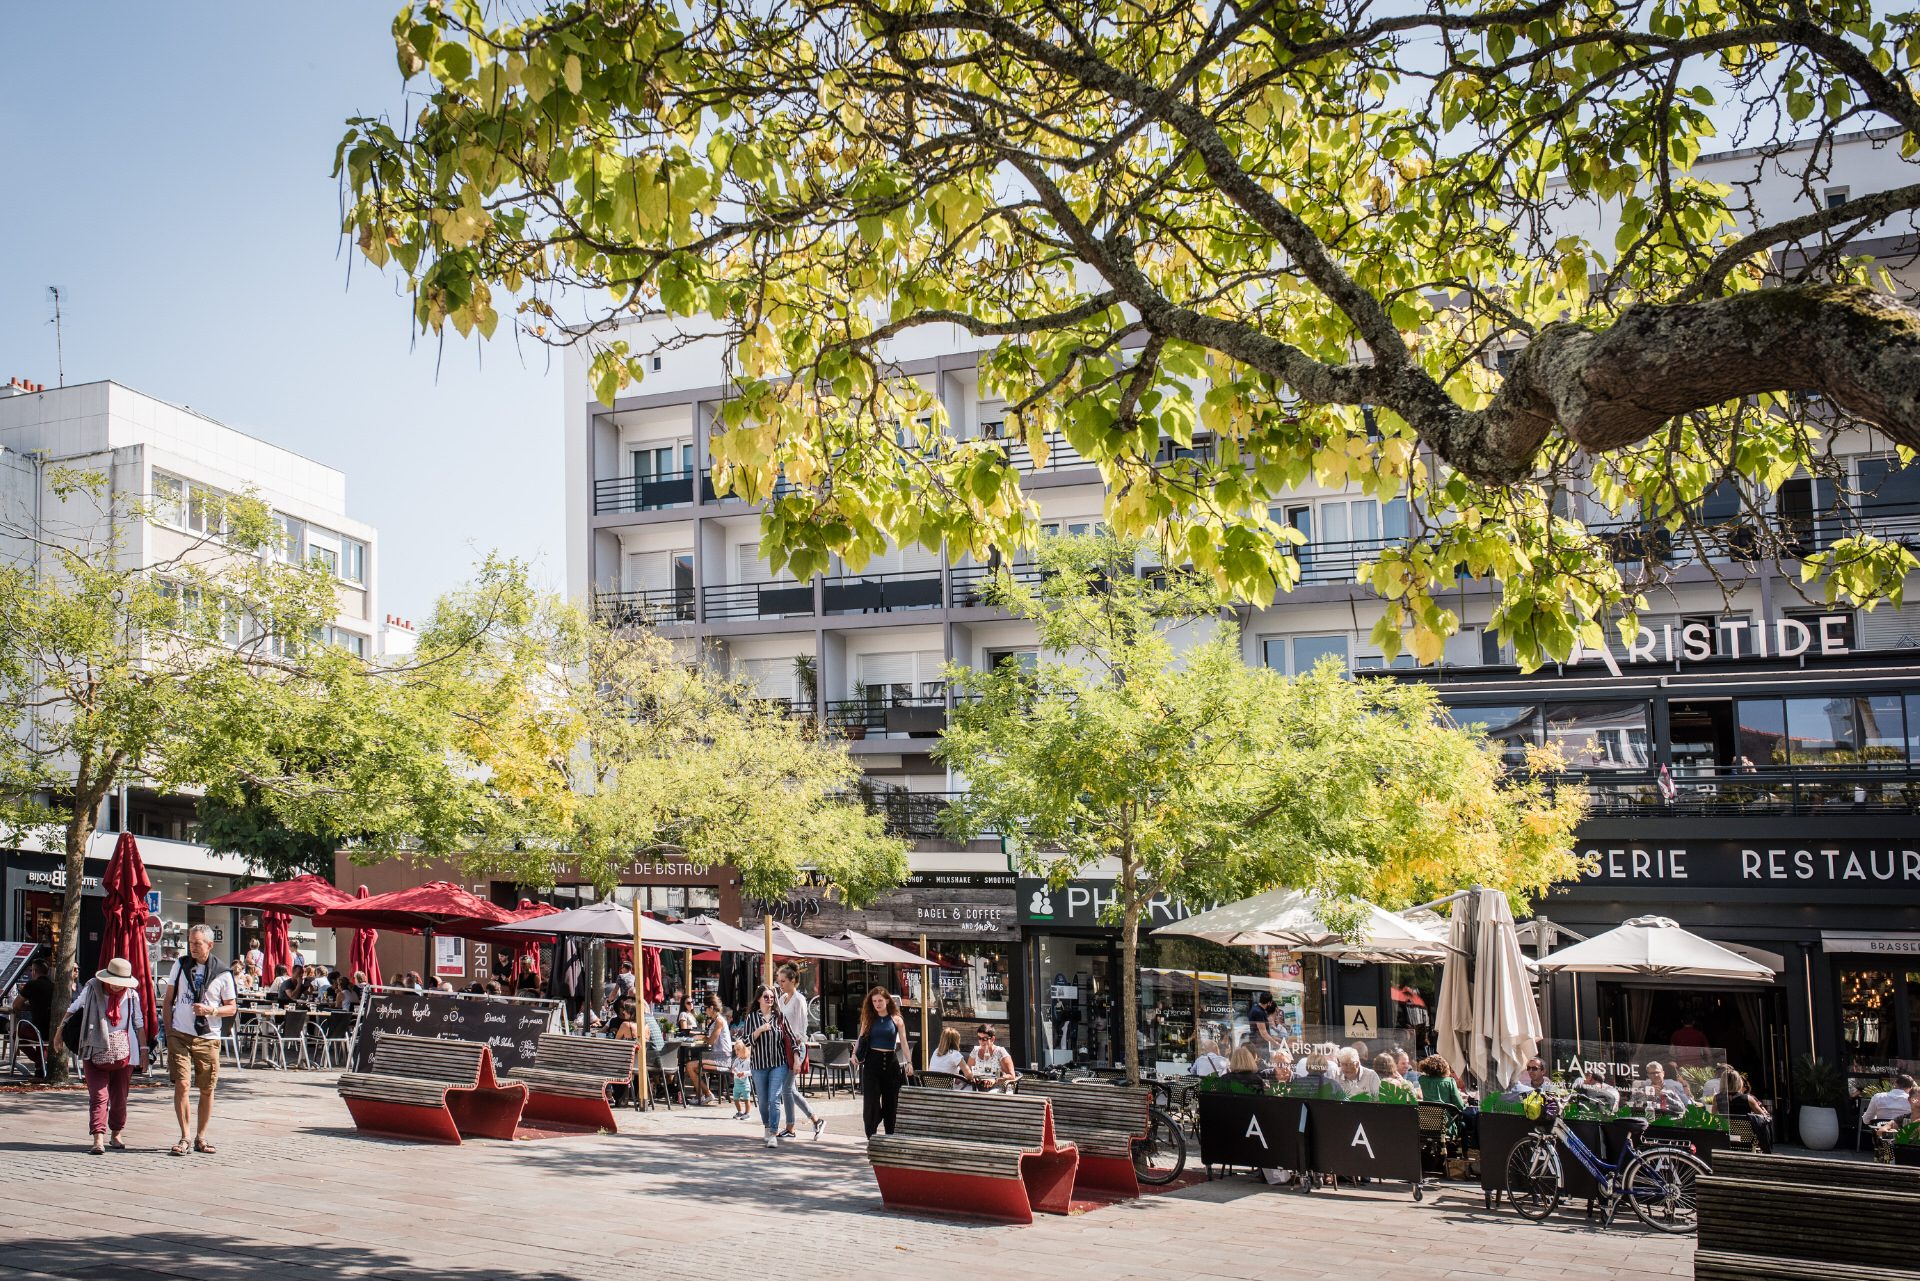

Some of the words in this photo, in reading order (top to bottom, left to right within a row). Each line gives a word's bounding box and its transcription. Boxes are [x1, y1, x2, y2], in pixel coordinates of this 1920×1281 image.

[634, 863, 652, 875] DE
[655, 863, 709, 876] BISTROT
[29, 872, 52, 883] BIJOU
[936, 876, 971, 884] MILKSHAKE
[984, 876, 1016, 884] SMOOTHIE
[918, 908, 948, 919] BAGEL
[952, 907, 961, 920] &
[966, 908, 1001, 920] COFFEE
[961, 922, 974, 930] AND
[973, 920, 999, 932] more
[938, 978, 964, 987] BAGELS
[1352, 1008, 1369, 1031] A
[1556, 1054, 1640, 1081] L'ARISTIDE
[1245, 1113, 1269, 1149] A
[1351, 1122, 1376, 1159] A
